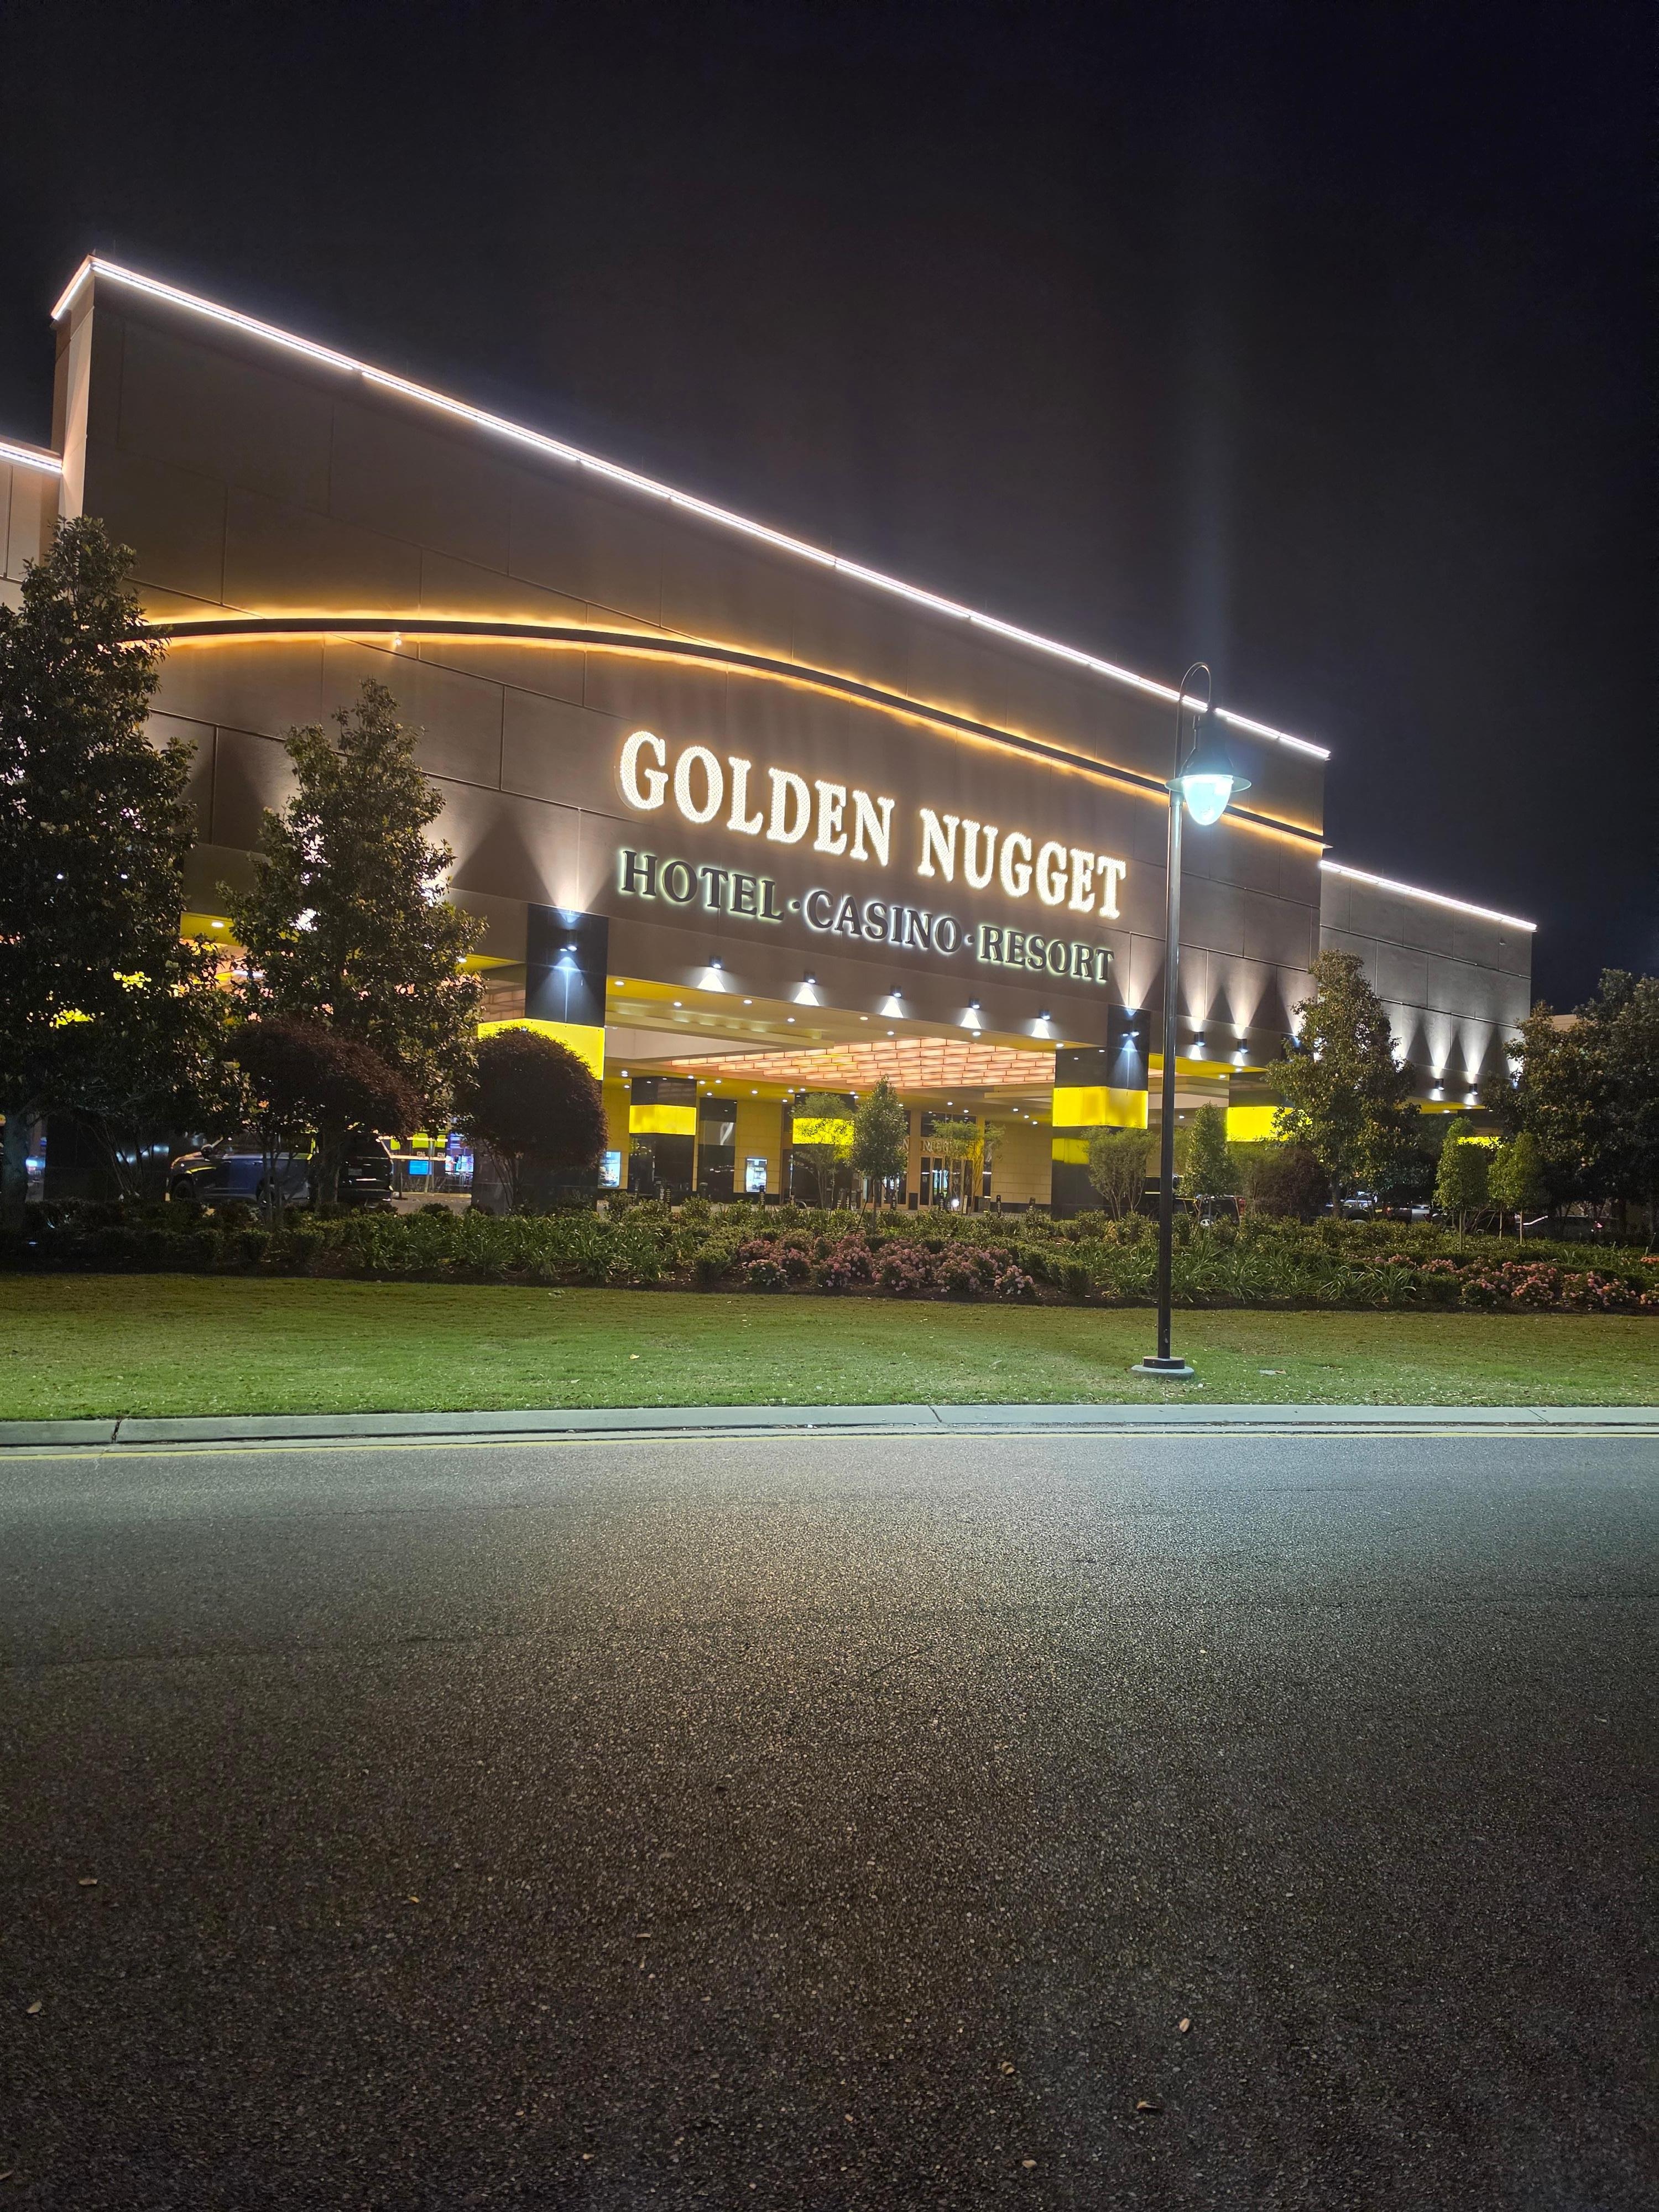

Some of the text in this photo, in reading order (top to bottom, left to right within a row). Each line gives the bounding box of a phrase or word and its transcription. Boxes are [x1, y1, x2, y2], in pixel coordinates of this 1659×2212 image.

[619, 731, 1126, 920] GOLDEN NUGGET
[622, 851, 1114, 980] HOTEL CASINO RESORT
